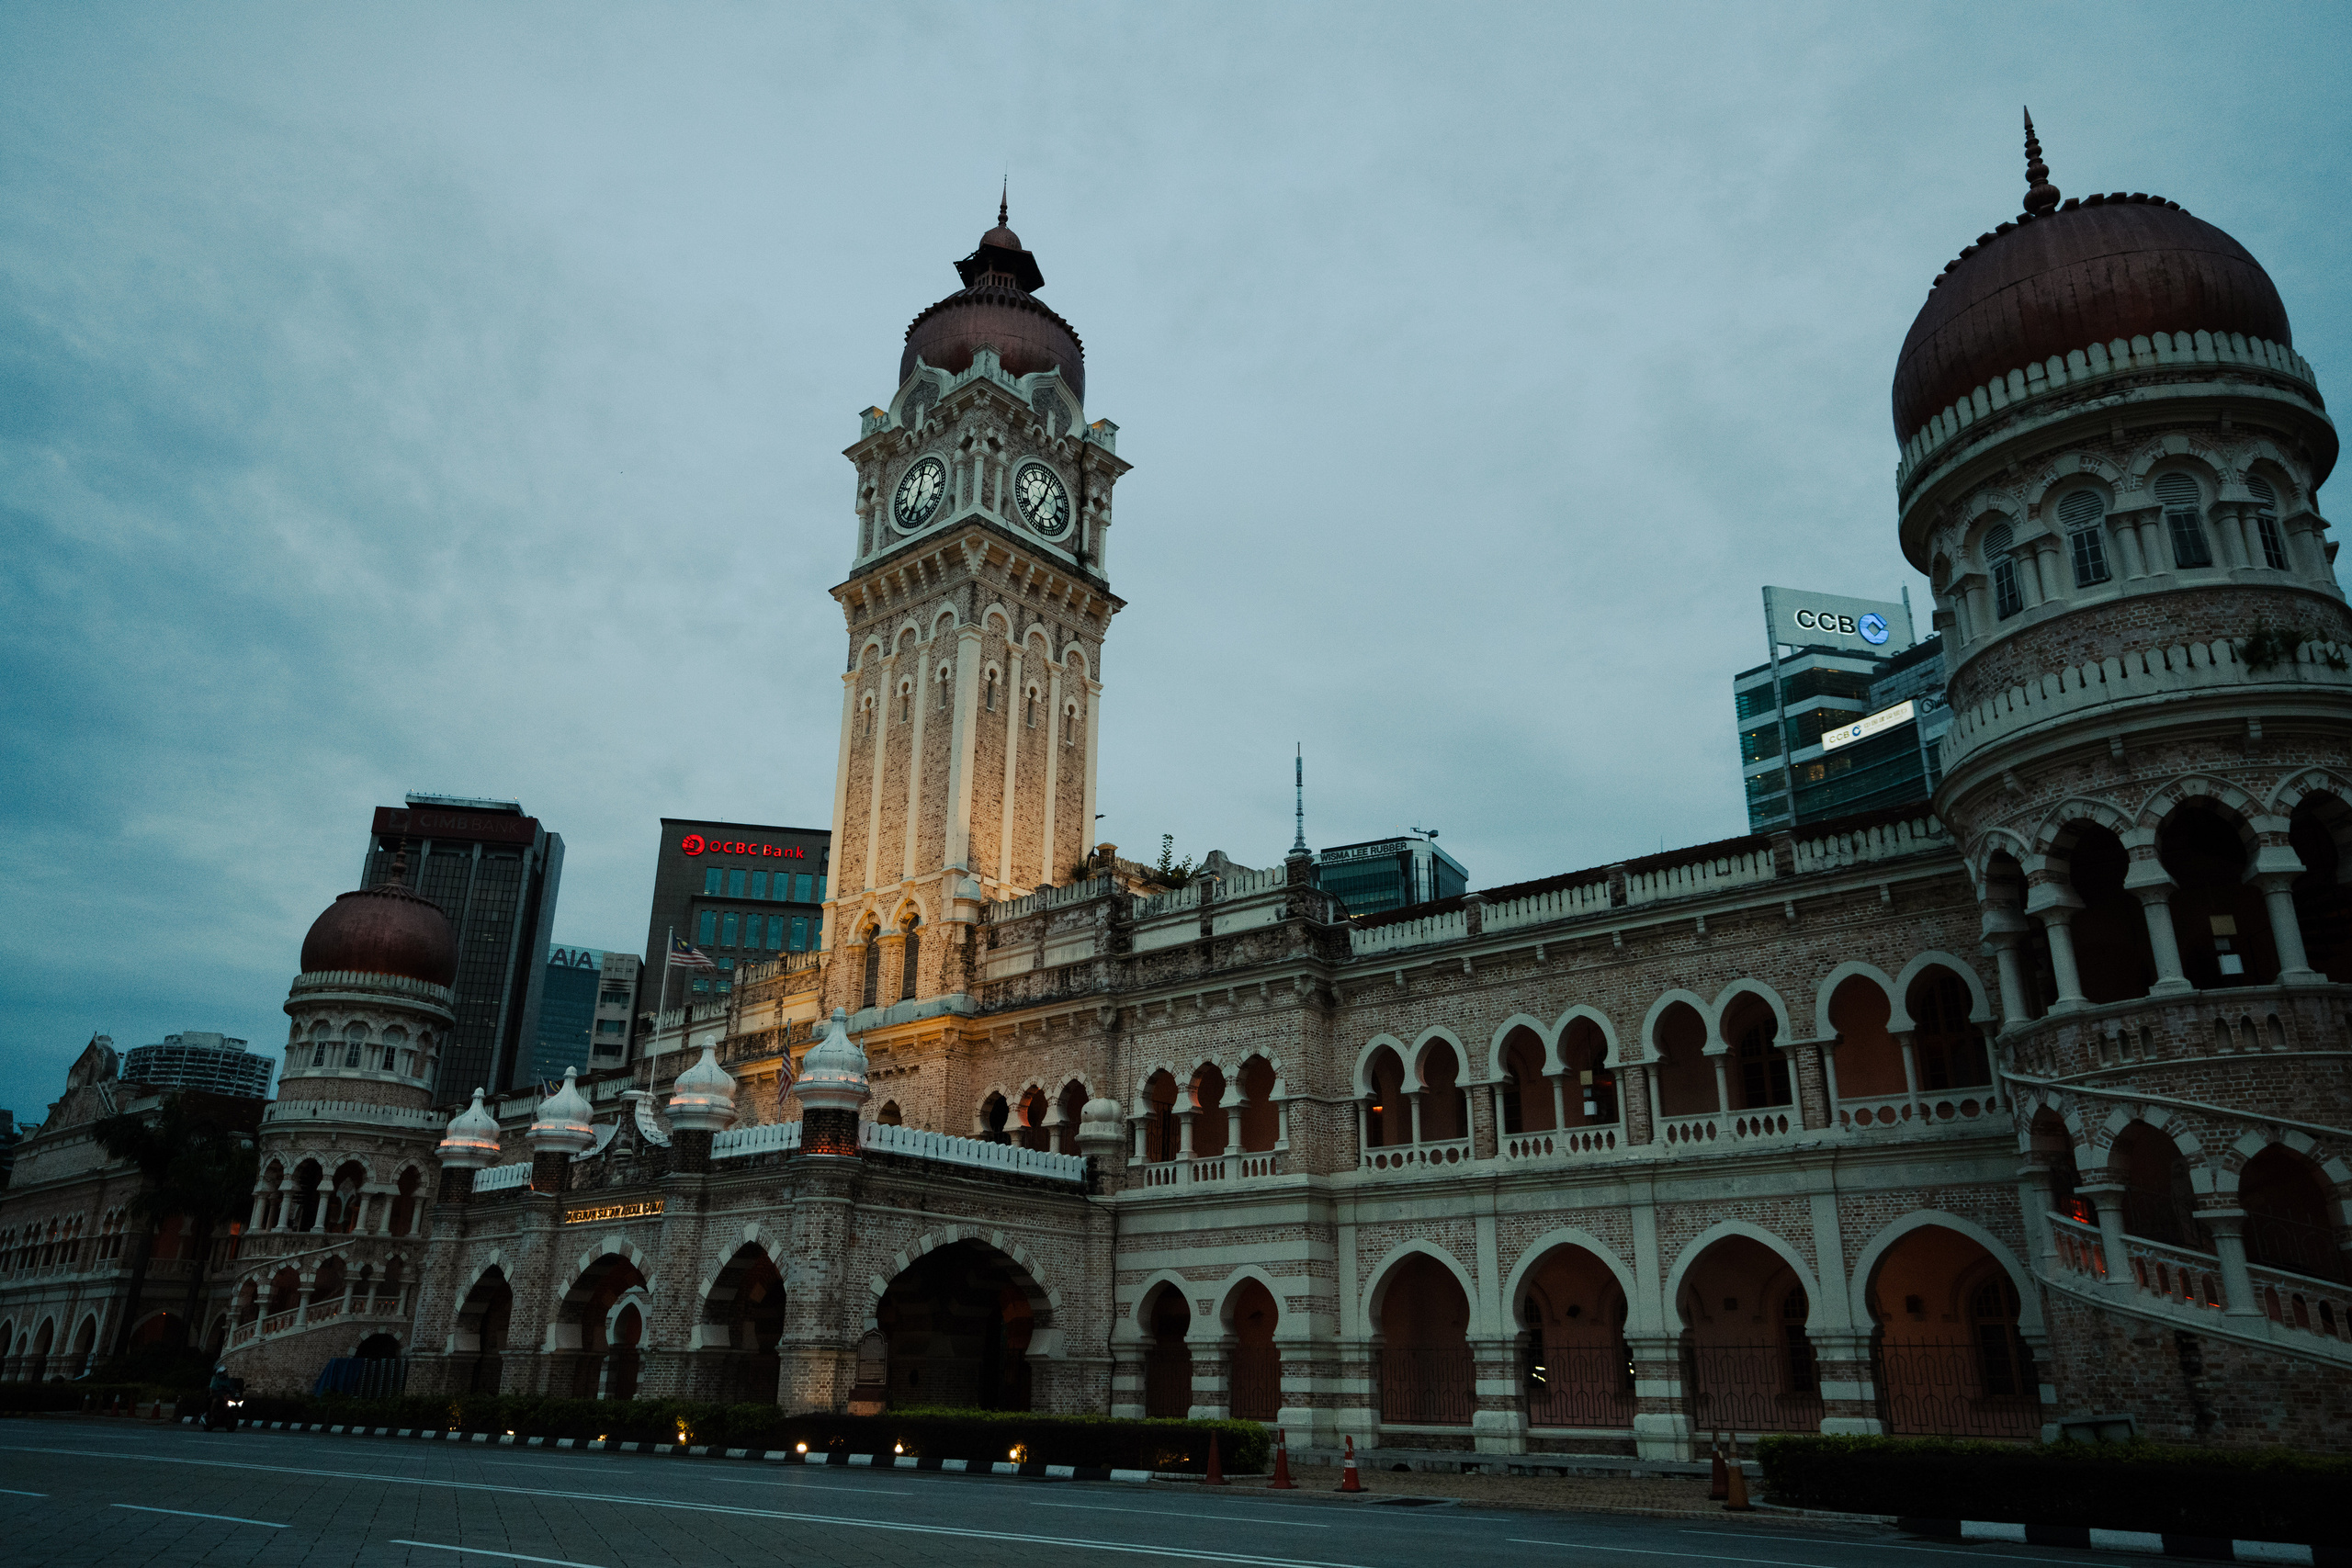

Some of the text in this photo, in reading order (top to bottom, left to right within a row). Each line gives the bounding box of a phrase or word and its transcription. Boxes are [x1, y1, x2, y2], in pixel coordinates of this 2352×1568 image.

[1795, 609, 1856, 636] CCB
[1828, 730, 1850, 744] CCB
[419, 814, 520, 833] CIMB BANK
[709, 840, 804, 859] OCBC Bank
[1320, 841, 1407, 862] WISMA LEE RUBBER
[550, 948, 594, 968] AIA
